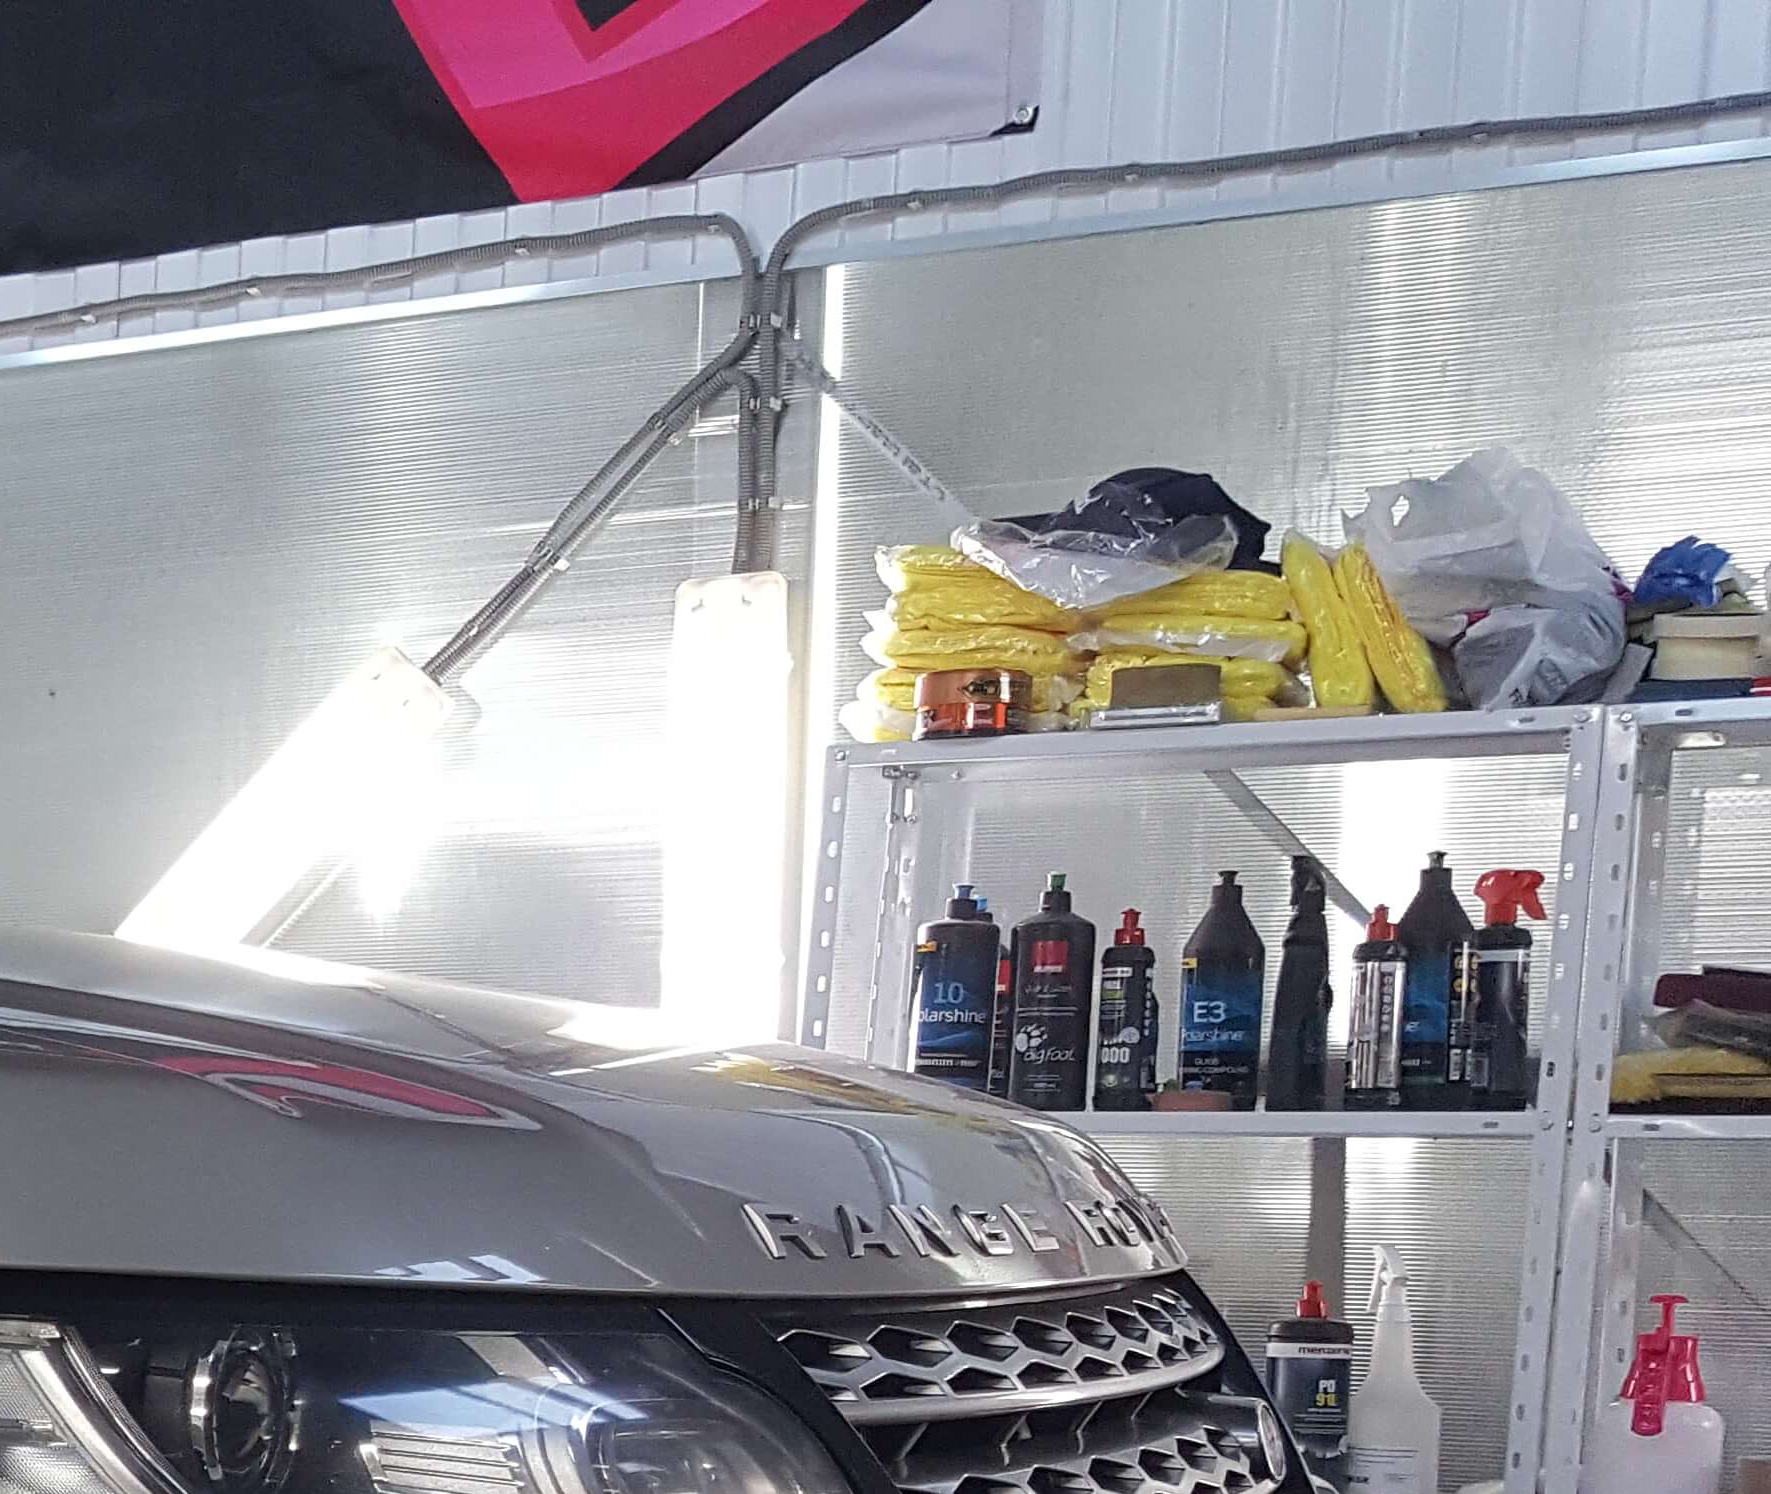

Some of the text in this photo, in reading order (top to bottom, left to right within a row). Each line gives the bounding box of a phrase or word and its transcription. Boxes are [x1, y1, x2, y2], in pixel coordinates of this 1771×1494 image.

[918, 1008, 986, 1024] olarshine
[1193, 1001, 1227, 1023] E3
[742, 1202, 1059, 1258] RANGE
